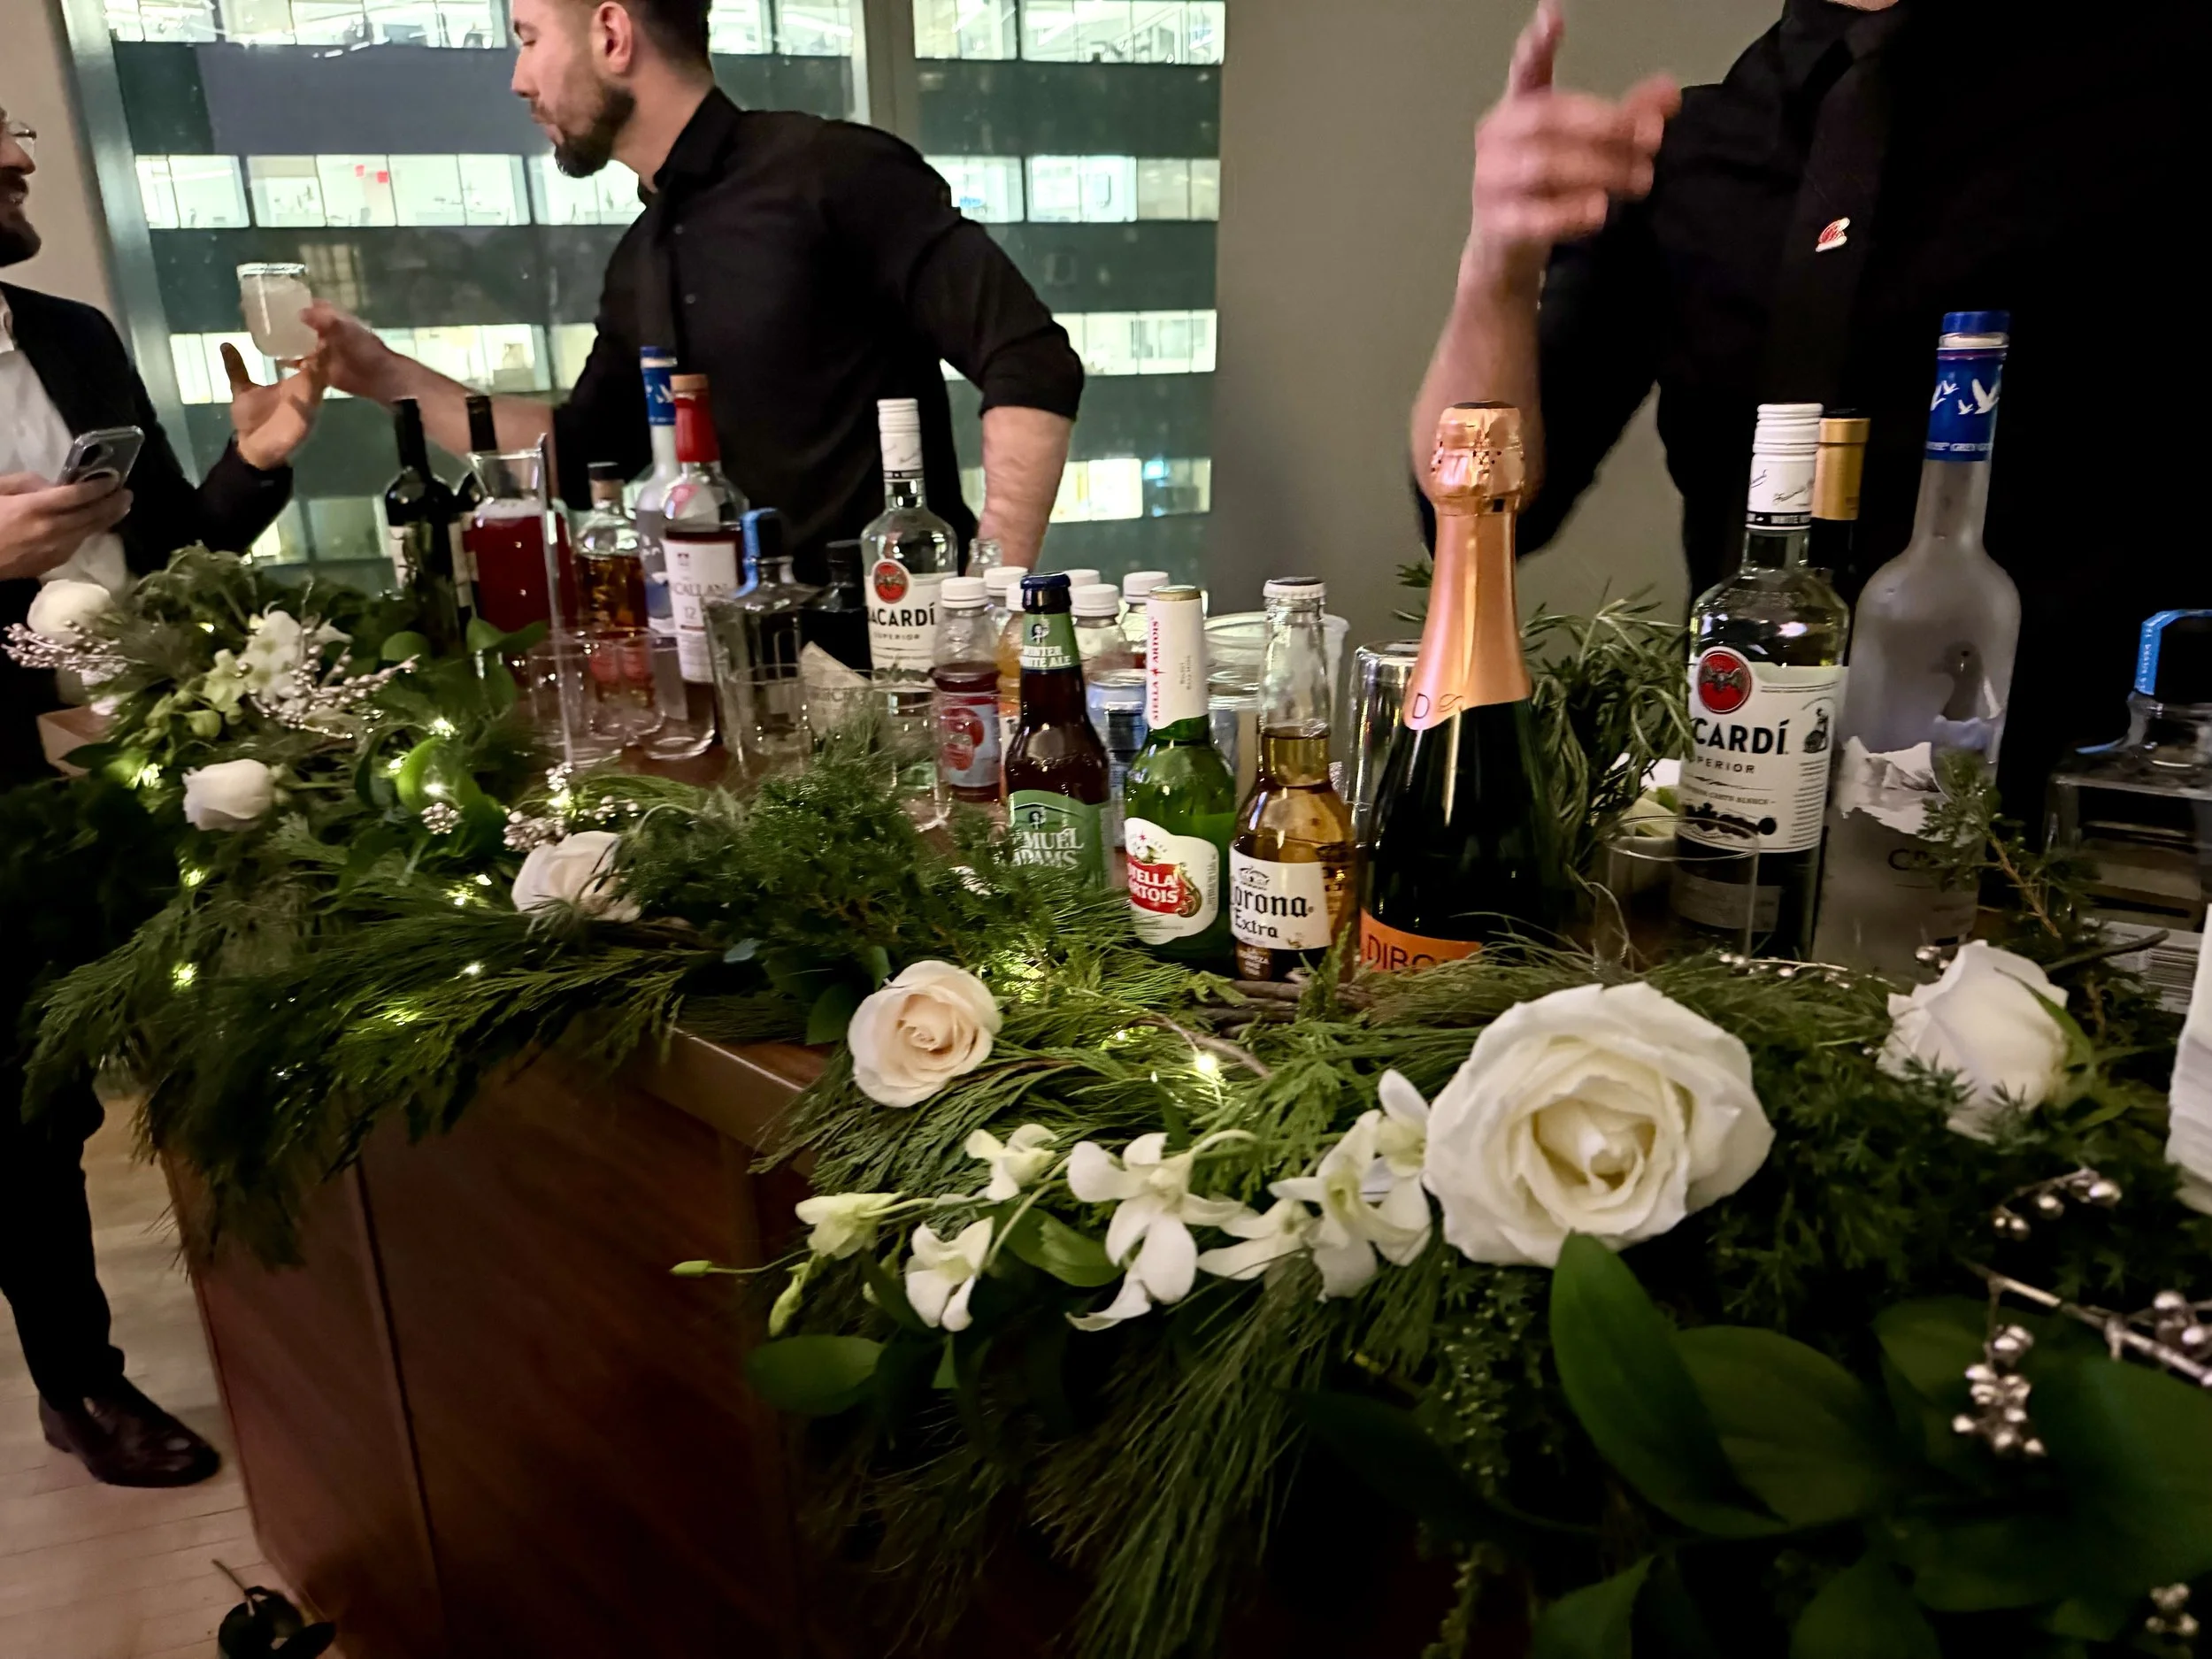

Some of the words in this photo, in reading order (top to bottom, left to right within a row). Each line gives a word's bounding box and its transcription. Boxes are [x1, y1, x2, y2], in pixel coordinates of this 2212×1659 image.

[868, 602, 935, 626] ACARDÍ
[1693, 718, 1791, 756] CARDÍ
[1696, 755, 1755, 774] PERIOR
[1018, 827, 1086, 850] MUEL
[1231, 885, 1309, 918] orona
[1234, 907, 1279, 939] Extra
